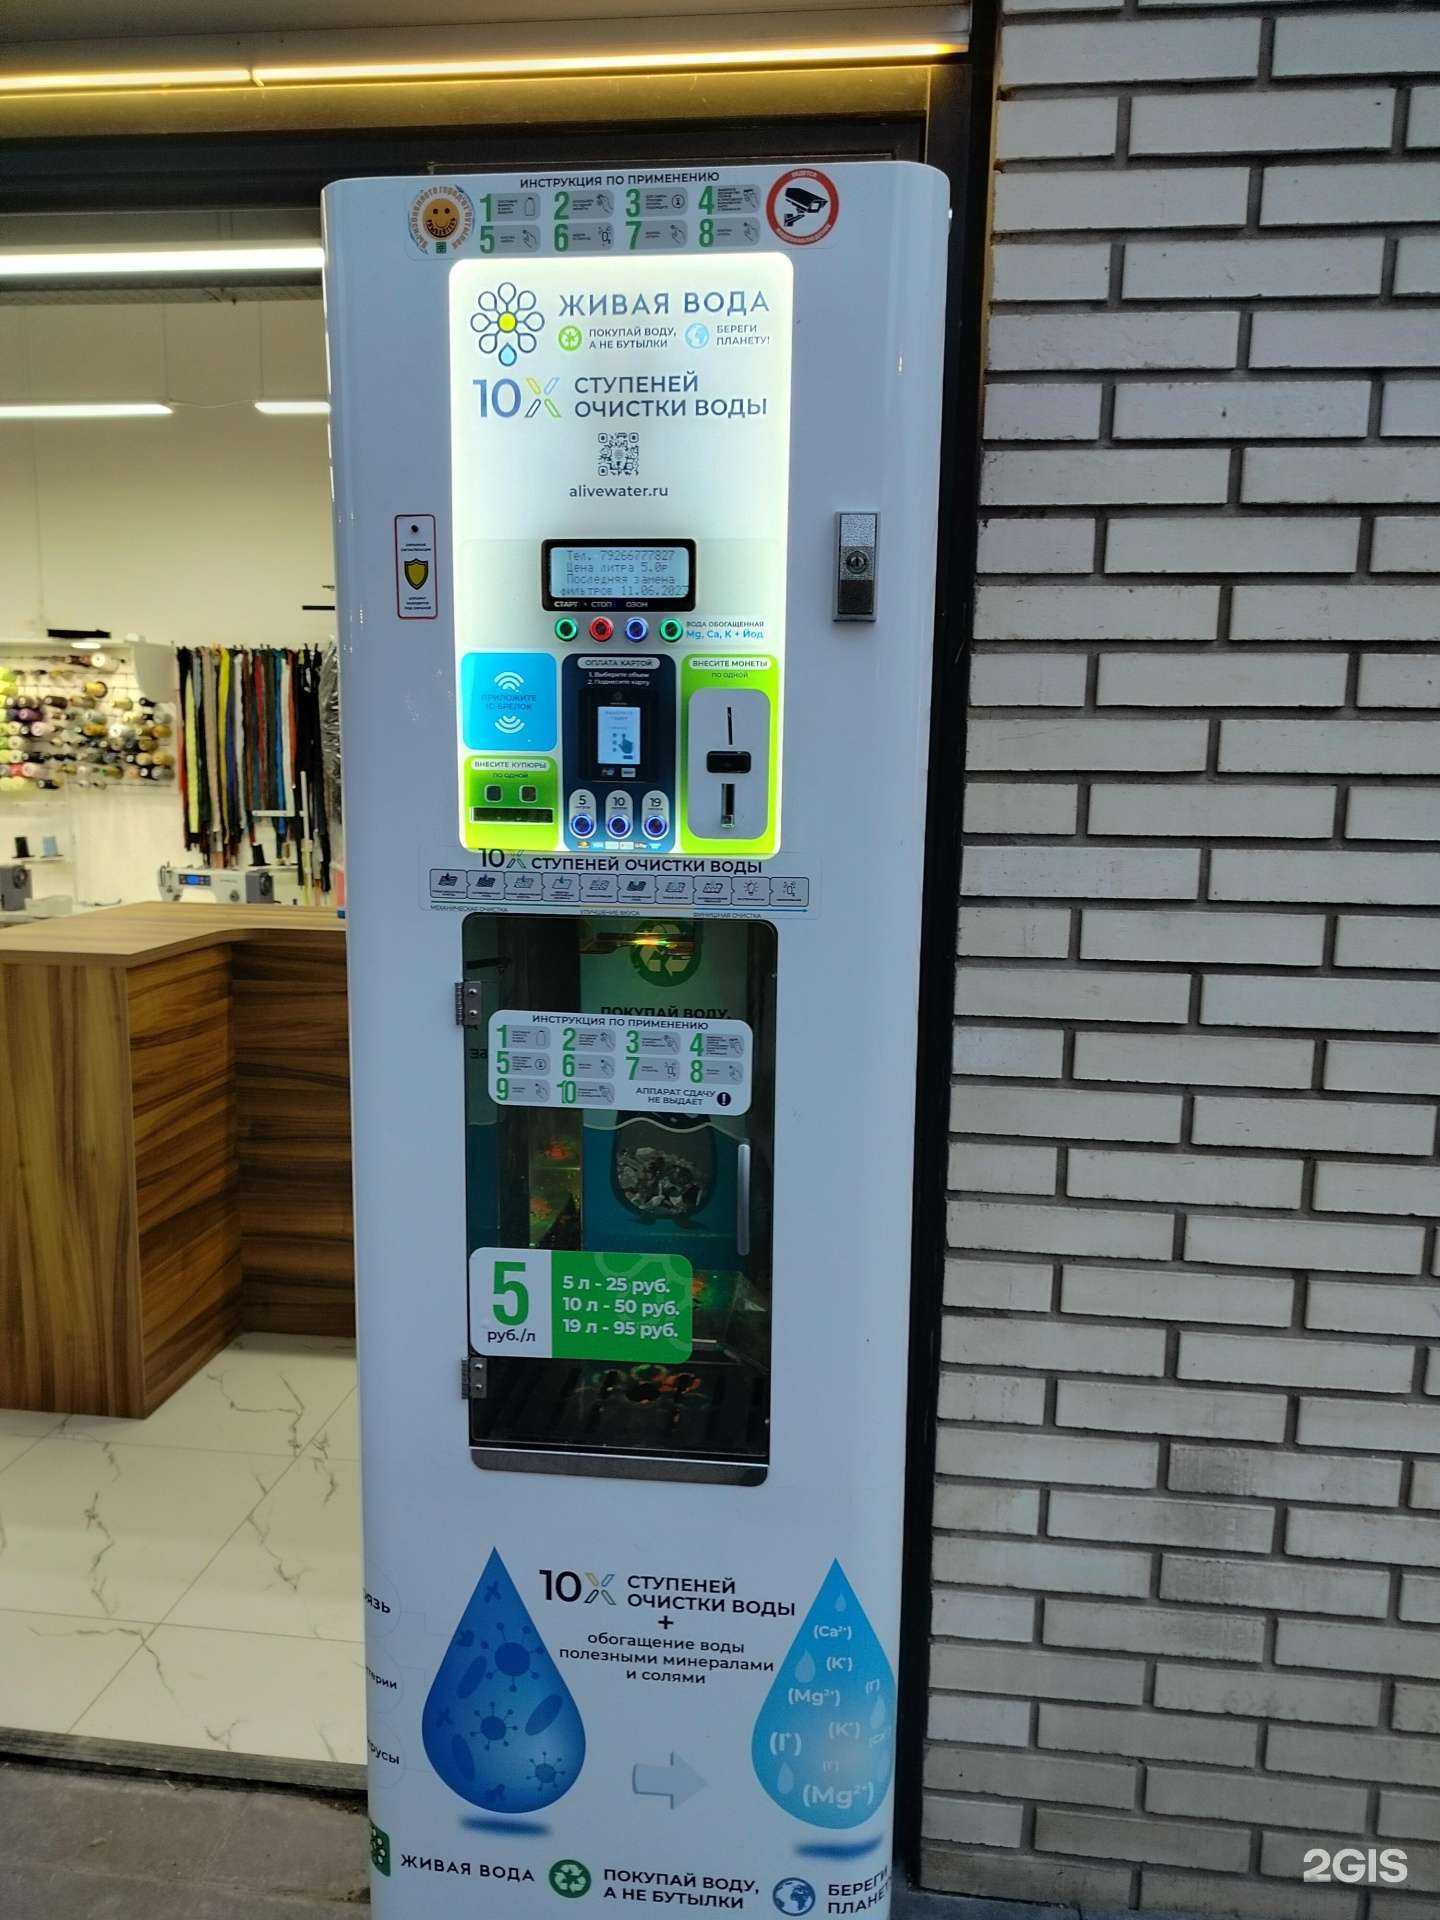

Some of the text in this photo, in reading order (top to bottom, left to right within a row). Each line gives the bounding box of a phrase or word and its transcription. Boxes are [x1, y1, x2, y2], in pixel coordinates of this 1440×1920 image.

[520, 171, 720, 190] ИНСТРУКЦИЯ ПО ПРИМЕНЕНИЮ
[480, 193, 492, 222] 1
[554, 191, 570, 220] 2
[626, 188, 641, 217] 3
[698, 185, 715, 215] 4
[480, 225, 495, 253] 5
[554, 223, 569, 252] 6
[625, 221, 642, 250] 7
[699, 218, 714, 247] 8
[559, 291, 770, 317] ЖИВАЯ ВОДА
[589, 326, 677, 338] ПОКУПАЙ ВОДУ,
[716, 324, 758, 334] БЕРЕГИ
[716, 335, 770, 346] ПЛАНЕТУ!
[589, 338, 668, 349] А НЕ БУТЫЛКИ
[575, 371, 698, 394] СТУПЕНЕЙ
[575, 398, 767, 419] ОЧИСТКИ ВОДЫ
[569, 485, 669, 498] alivewater.ru
[687, 630, 705, 639] Mg,
[707, 630, 722, 639] Ca,
[743, 628, 764, 638] Йод
[511, 761, 547, 769] КУПЮРЫ
[578, 794, 587, 805] 5
[612, 797, 626, 806] 10
[649, 797, 662, 807] 19
[531, 856, 619, 871] СТУПЕНЕЙ
[625, 858, 705, 872] ОЧИСТКИ
[710, 860, 762, 875] ВОДЫ
[532, 1015, 708, 1030] ИНСТРУКЦИЯ ПО ПРИМЕНЕНИЮ
[496, 1025, 508, 1048] 1
[562, 1027, 576, 1051] 2
[626, 1030, 640, 1054] 3
[689, 1033, 704, 1056] 4
[496, 1051, 509, 1074] 5
[562, 1054, 575, 1077] 6
[625, 1056, 640, 1080] 7
[690, 1060, 703, 1083] 8
[496, 1078, 509, 1101] 9
[557, 1080, 577, 1104] 10
[636, 1087, 716, 1098] АППАРАТ СДАЧУ
[648, 1096, 704, 1106] НЕ ВЫДАЕТ
[493, 1261, 530, 1326] 5
[562, 1275, 574, 1289] 5
[578, 1279, 590, 1290] л
[606, 1277, 628, 1292] 25
[632, 1278, 670, 1295] руб.
[562, 1297, 582, 1312] 10
[585, 1301, 598, 1312] л
[614, 1299, 637, 1314] 50
[642, 1300, 680, 1318] руб.
[488, 1328, 536, 1343] руб./л
[562, 1318, 581, 1333] 19
[585, 1322, 598, 1334] л
[613, 1321, 636, 1336] 95
[640, 1322, 678, 1340] руб.
[627, 1575, 736, 1594] СТУПЕНЕЙ
[364, 1590, 391, 1614] язь
[627, 1593, 796, 1618] ОЧИСТКИ ВОДЫ
[658, 1615, 675, 1630] +
[587, 1632, 745, 1656] обогащение воды
[560, 1648, 774, 1673] полезными минералами
[366, 1666, 397, 1689] терии
[626, 1670, 706, 1685] и солями
[367, 1737, 400, 1765] русы
[401, 1854, 535, 1883] ЖИВАЯ ВОДА
[604, 1868, 759, 1895] ПОКУПАЙ ВОДУ,
[603, 1887, 744, 1909] А НЕ БУТЫЛКИ
[828, 1881, 889, 1914] ПЛАНЕТ
